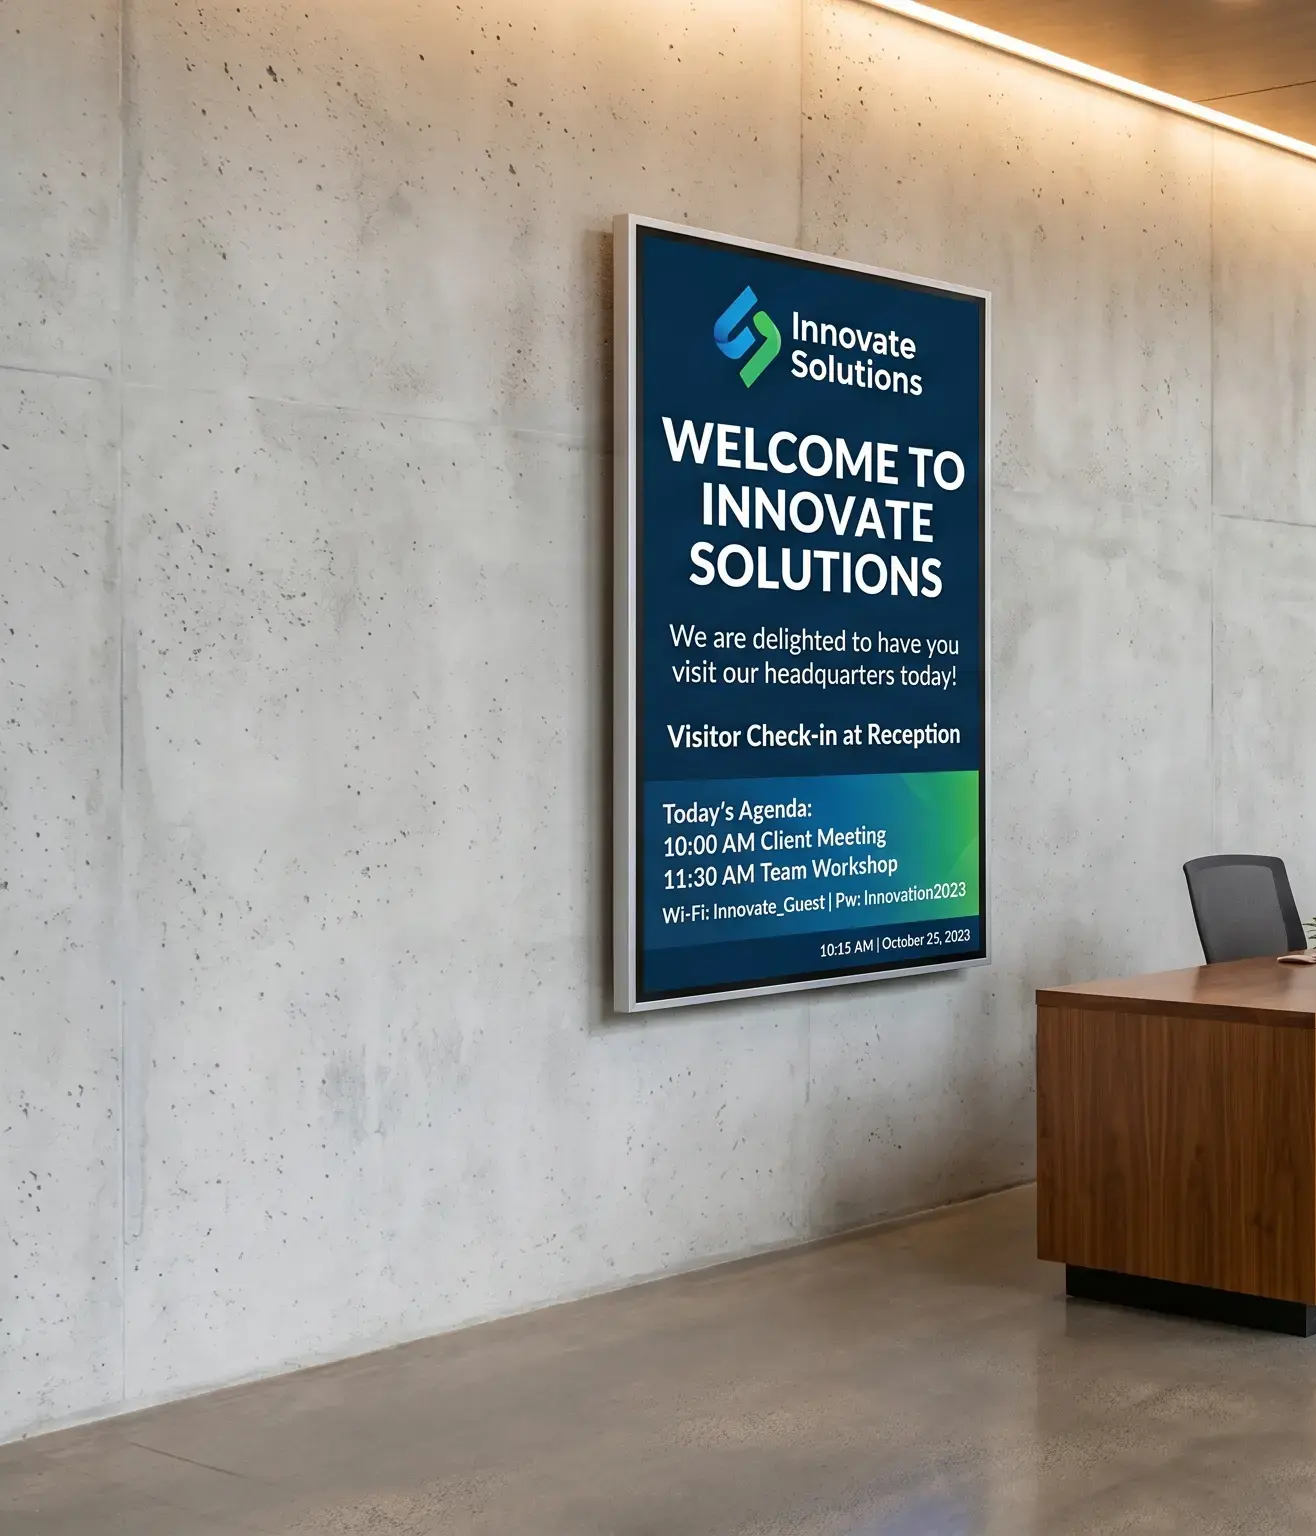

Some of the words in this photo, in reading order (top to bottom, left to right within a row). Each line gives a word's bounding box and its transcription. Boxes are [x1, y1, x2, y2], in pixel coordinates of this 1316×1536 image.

[791, 311, 916, 362] Innovate
[790, 348, 923, 396] Solutions
[661, 416, 899, 486] WELCOME
[908, 446, 965, 491] TO
[702, 481, 934, 544] INNOVATE
[689, 540, 943, 598] SOLUTIONS
[669, 623, 707, 648] We
[713, 631, 747, 649] are
[752, 626, 846, 656] delighted
[851, 631, 872, 653] to
[878, 630, 922, 654] have
[926, 638, 959, 659] you
[671, 659, 717, 683] visit
[723, 666, 759, 684] our
[765, 660, 895, 690] headquarters
[900, 664, 957, 691] today!
[666, 723, 742, 748] Visitor
[746, 723, 837, 747] Check-in
[842, 725, 863, 746] at
[868, 722, 961, 749] Reception
[662, 800, 735, 827] Today's
[738, 797, 812, 825] Agenda:
[664, 834, 718, 857] 10:00
[721, 832, 755, 854] AM
[760, 829, 813, 851] Client
[817, 825, 887, 849] Meeting
[664, 866, 718, 890] 11:30
[721, 863, 755, 886] AM
[759, 862, 807, 882] Team
[811, 854, 898, 878] Workshop
[662, 904, 710, 924] Wi-Fi:
[713, 894, 826, 920] Innovate_Guest
[835, 892, 861, 909] Pw:
[864, 881, 967, 906] Innovation2023
[820, 941, 852, 958] 10:15
[854, 939, 874, 954] AM
[881, 934, 925, 950] October
[926, 931, 942, 946] 25,
[944, 928, 971, 943] 2023
